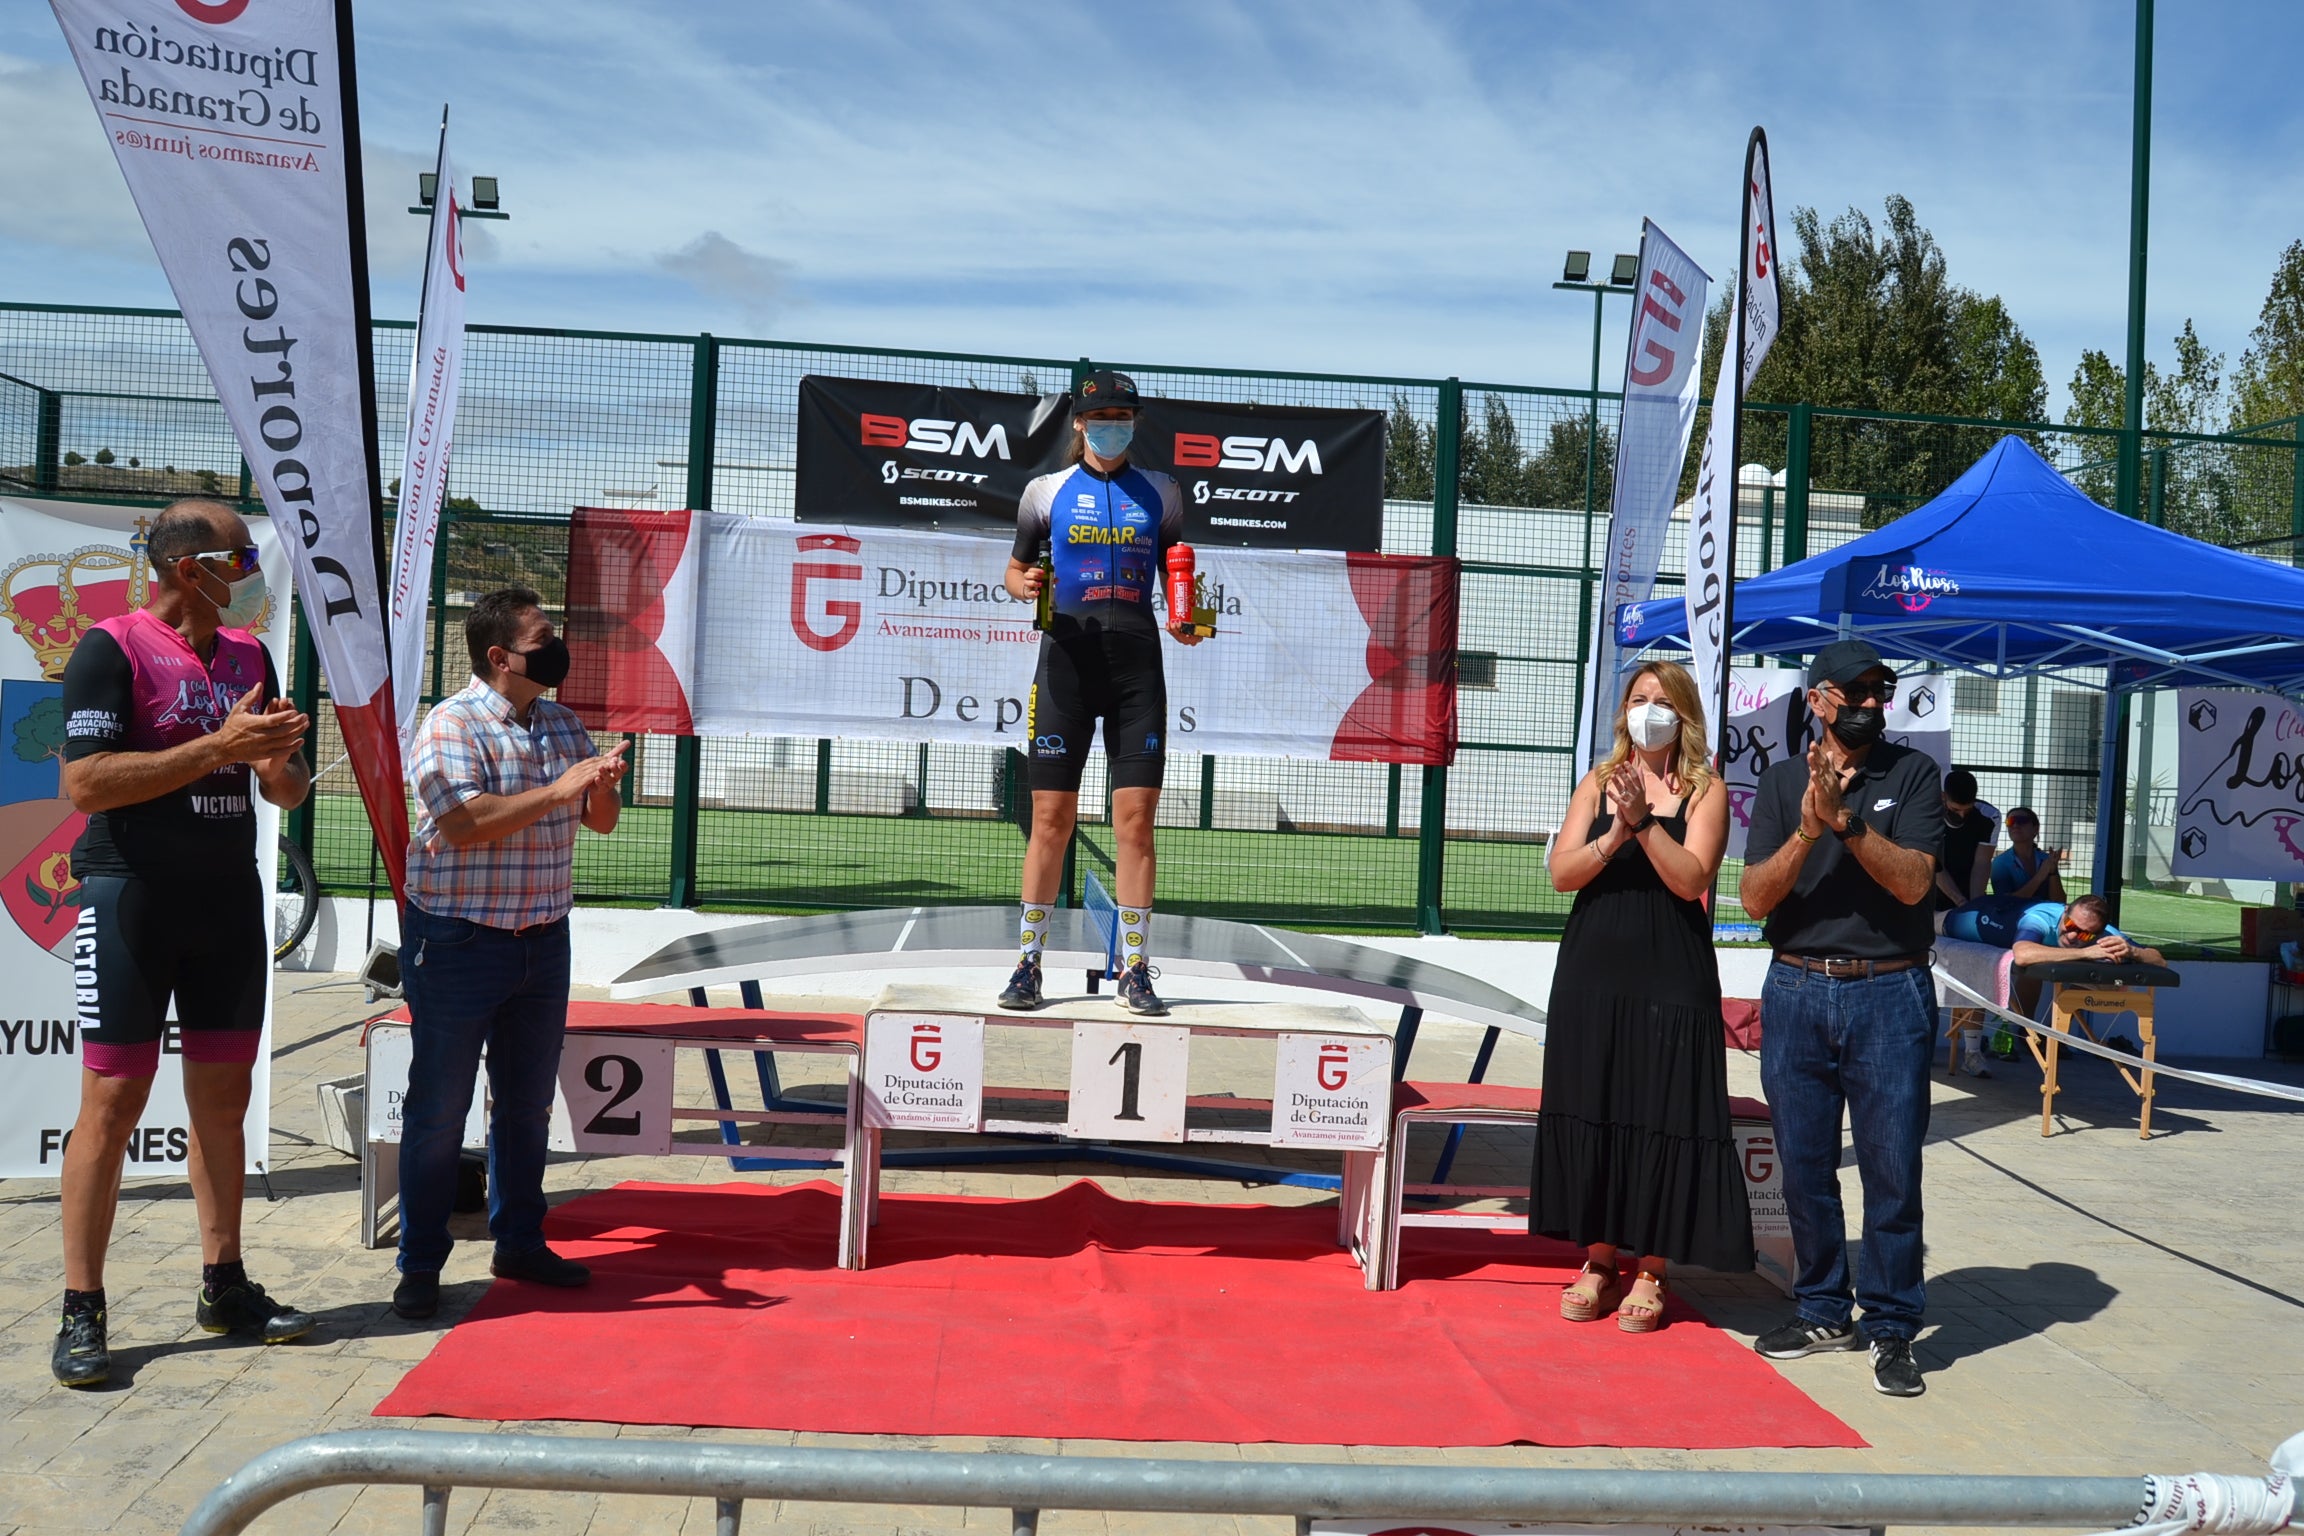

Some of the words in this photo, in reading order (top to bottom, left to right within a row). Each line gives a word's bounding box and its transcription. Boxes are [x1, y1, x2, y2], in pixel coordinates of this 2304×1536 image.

[418, 347, 446, 447] Granada
[861, 413, 1011, 460] BSM
[1174, 432, 1323, 475] BSM
[413, 451, 427, 480] de
[901, 467, 988, 484] SCOTT
[900, 496, 977, 507] BSMBIKES.COM
[1212, 488, 1300, 503] SCOTT
[1210, 516, 1287, 530] BSMBIKES.COM
[1068, 524, 1135, 545] SEMAR
[394, 481, 421, 619] Diputación
[877, 618, 981, 641] Avanzamos
[985, 624, 1040, 645] junt@
[71, 708, 110, 720] AGRÍCOLA
[110, 713, 117, 721] Y
[66, 719, 123, 732] EXCAVACIONES
[1726, 725, 1778, 777] os
[191, 795, 247, 814] VICTORIA
[75, 907, 101, 1029] VICTORIA
[884, 1074, 964, 1091] Diputación
[1108, 1042, 1145, 1121] 1
[584, 1054, 643, 1136] 2
[883, 1091, 900, 1105] de
[902, 1091, 963, 1107] Granada
[1291, 1093, 1369, 1110] Diputación
[1290, 1110, 1307, 1123] de
[1309, 1110, 1368, 1126] Granada
[1292, 1130, 1337, 1139] Avanzamos
